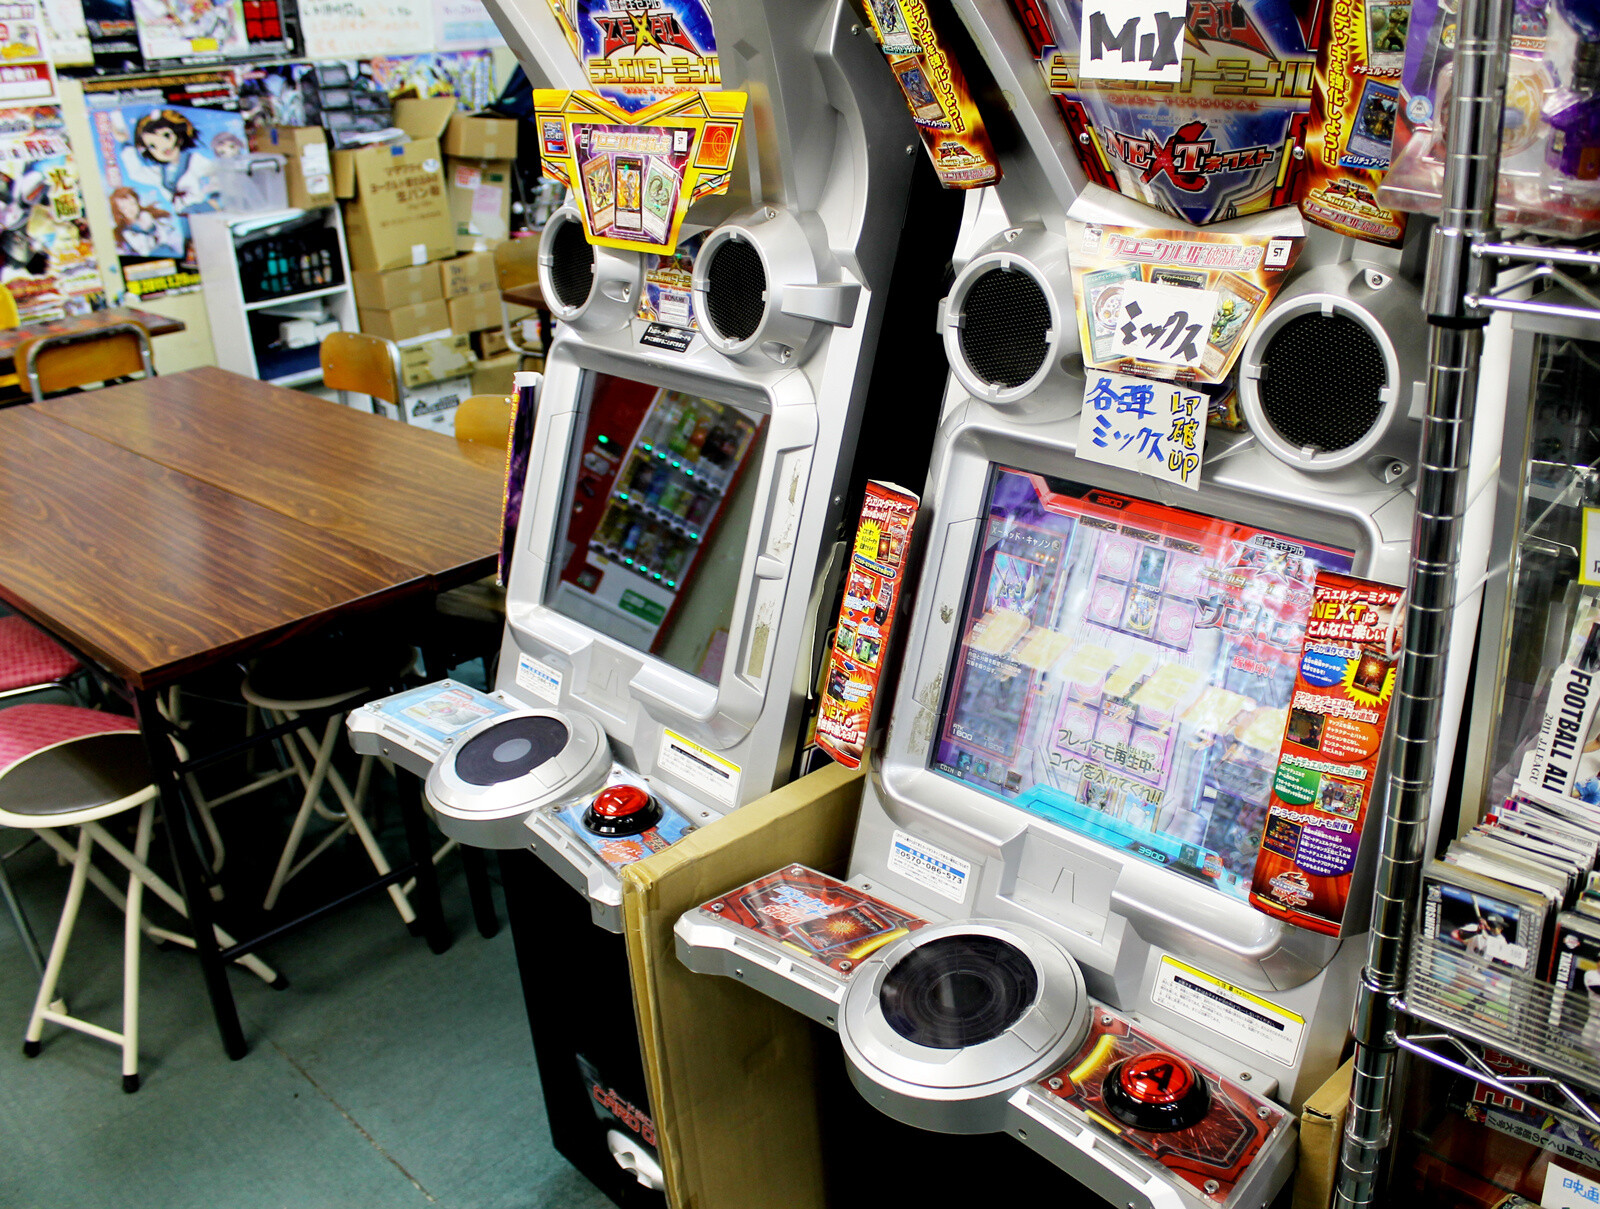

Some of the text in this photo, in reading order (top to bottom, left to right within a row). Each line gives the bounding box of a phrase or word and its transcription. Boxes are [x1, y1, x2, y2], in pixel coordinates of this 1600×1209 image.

[1104, 121, 1214, 192] NEXT
[1204, 146, 1275, 175] ネクスト
[1120, 301, 1202, 362] ミックス
[1086, 377, 1156, 420] 各弾
[1092, 414, 1164, 463] ミックス
[1316, 588, 1399, 604] デュエルターミナル
[1542, 712, 1553, 734] 2011
[1550, 669, 1593, 760] FOOTBALL
[940, 763, 954, 774] COIN
[900, 850, 963, 885] 0570-086-573
[1138, 846, 1165, 863] 3900
[1133, 1063, 1175, 1092] A
